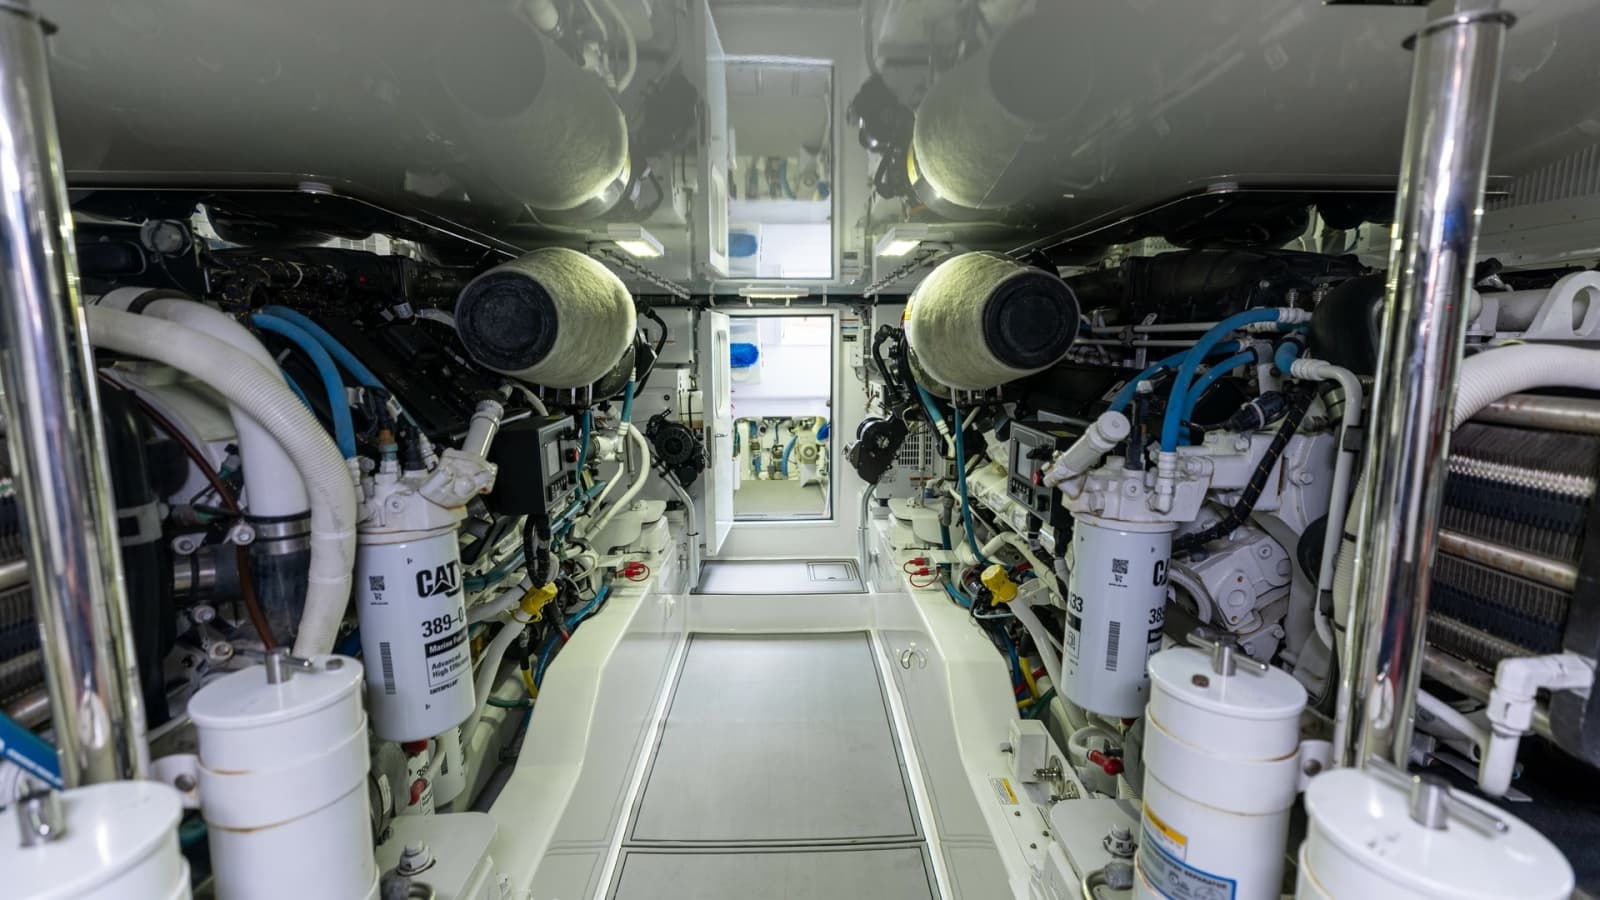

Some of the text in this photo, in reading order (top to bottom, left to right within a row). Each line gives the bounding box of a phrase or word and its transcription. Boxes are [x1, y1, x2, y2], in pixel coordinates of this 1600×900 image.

[416, 559, 459, 598] CAT
[428, 639, 453, 654] Marine
[431, 652, 462, 671] Advanced
[432, 666, 449, 679] High
